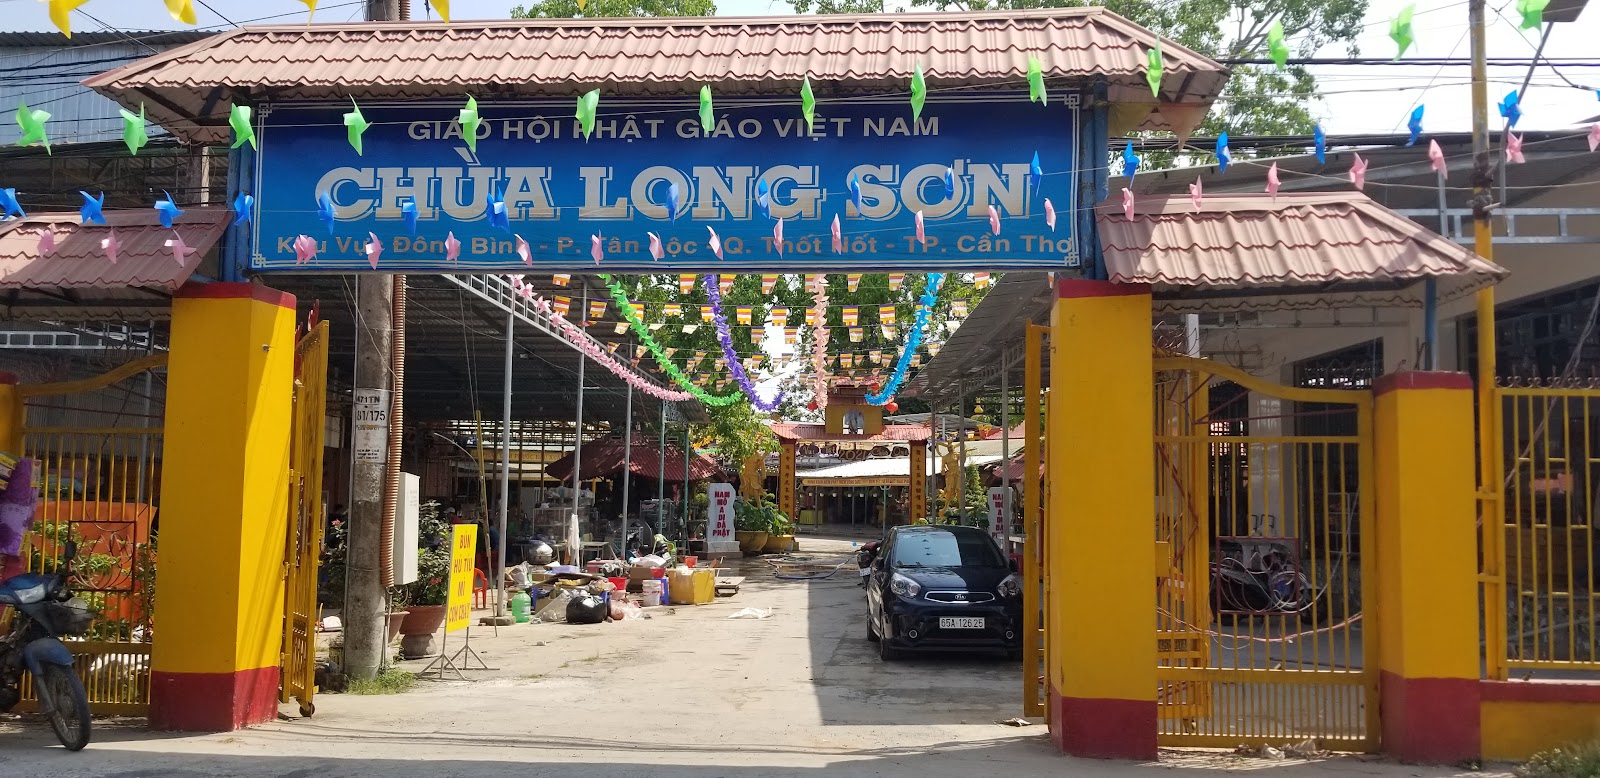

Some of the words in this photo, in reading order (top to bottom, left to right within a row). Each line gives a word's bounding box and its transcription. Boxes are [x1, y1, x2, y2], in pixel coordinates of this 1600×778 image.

[503, 115, 560, 143] HỘI
[676, 113, 762, 138] GÁO
[773, 112, 851, 141] VIỆT
[863, 117, 939, 137] NAM
[315, 147, 560, 222] CHÙA
[578, 165, 827, 221] LONG
[846, 159, 1030, 221] SƠN
[278, 236, 326, 254] Ku
[393, 235, 461, 257] Đôn
[472, 237, 523, 254] Bìn
[557, 237, 581, 254] P.
[595, 237, 639, 254] ân
[649, 237, 697, 258] ộc
[724, 237, 751, 254] Q.
[903, 236, 947, 253] TP.
[957, 232, 1010, 253] Cần
[1020, 235, 1073, 253] Thơ
